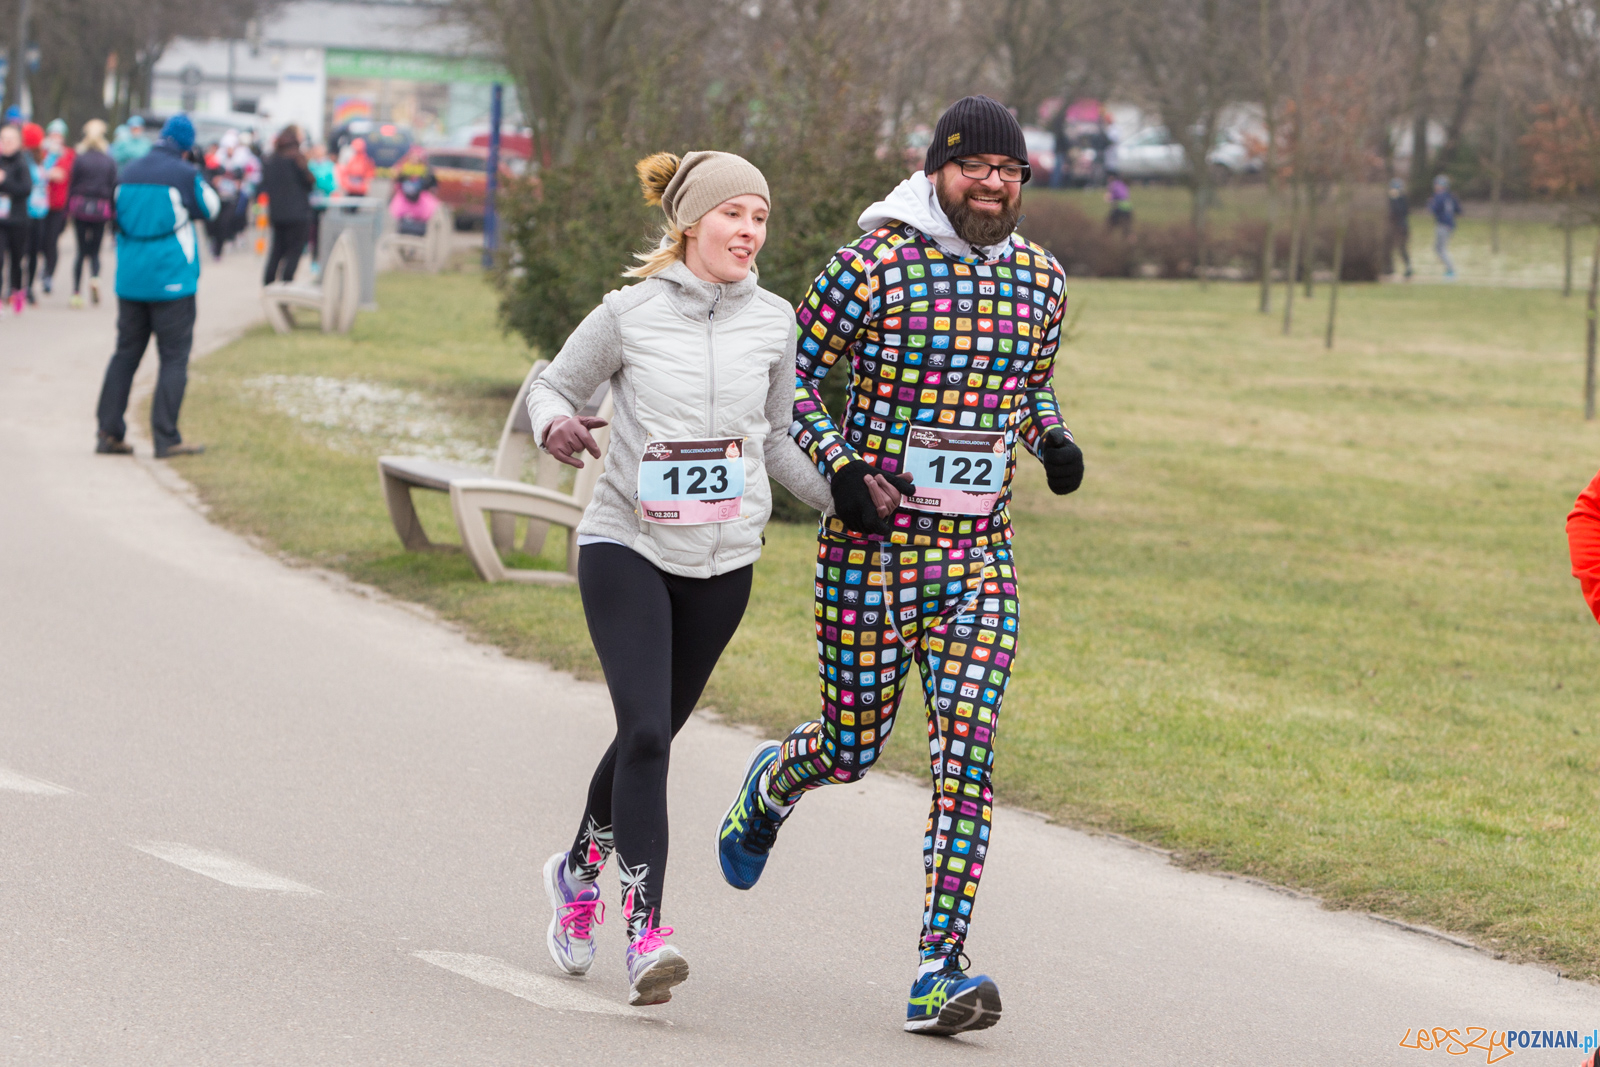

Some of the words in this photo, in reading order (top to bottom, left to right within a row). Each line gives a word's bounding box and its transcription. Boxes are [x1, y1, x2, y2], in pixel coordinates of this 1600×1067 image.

[928, 455, 993, 486] 122
[662, 465, 729, 495] 123
[908, 496, 940, 506] 11.02.2018
[647, 510, 679, 519] 11.02.2018
[903, 611, 914, 619] 14
